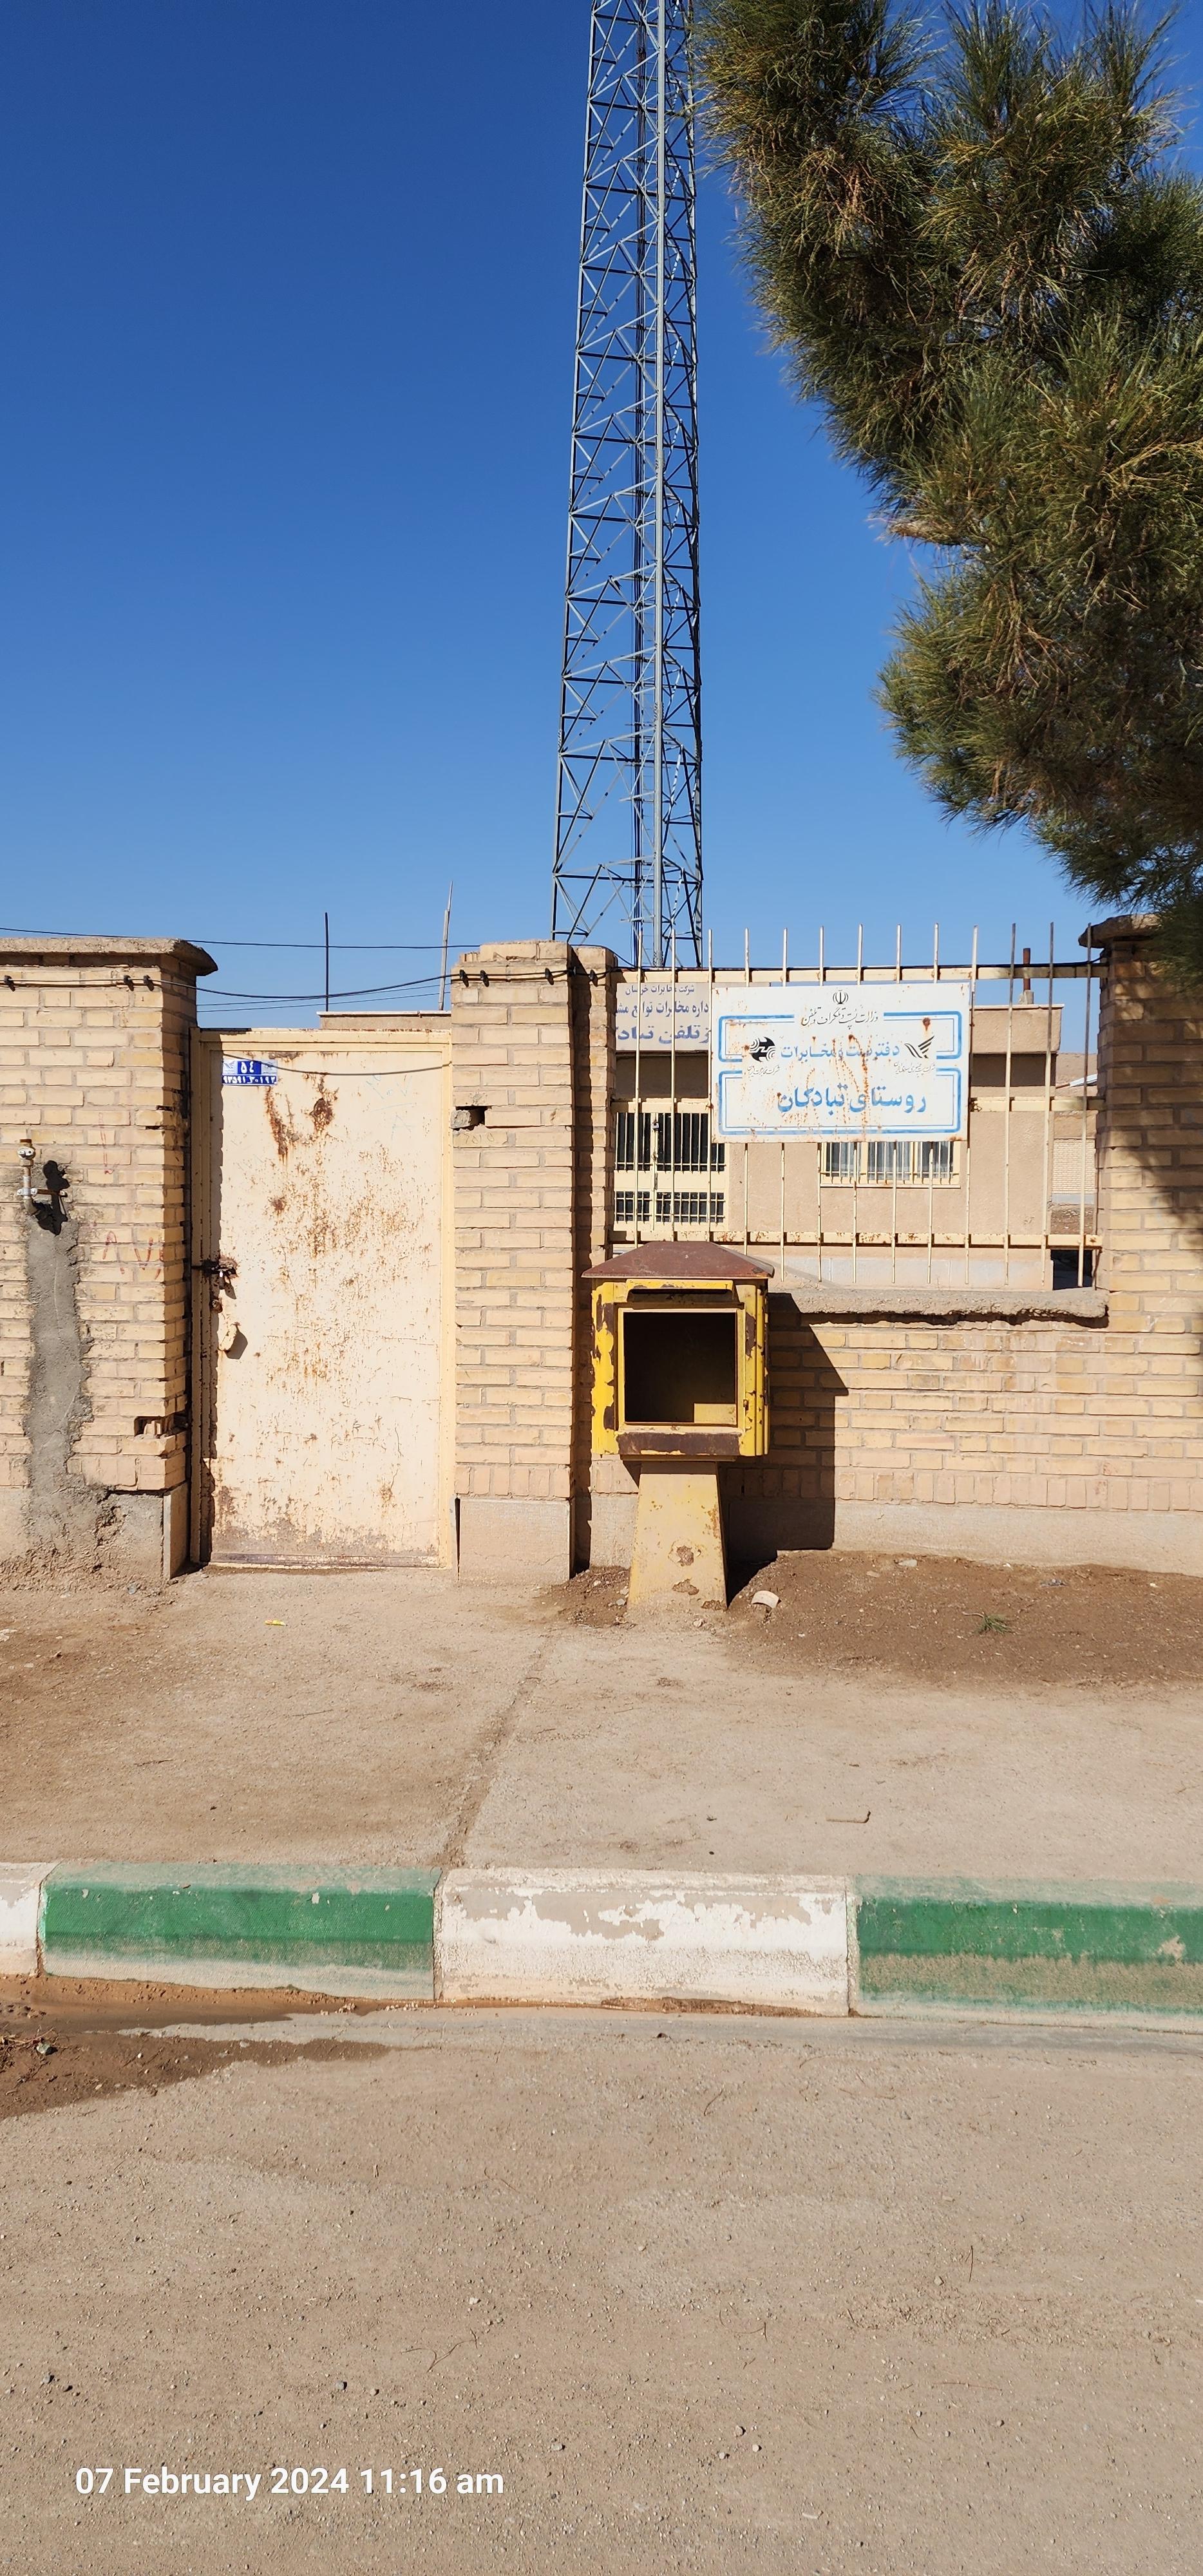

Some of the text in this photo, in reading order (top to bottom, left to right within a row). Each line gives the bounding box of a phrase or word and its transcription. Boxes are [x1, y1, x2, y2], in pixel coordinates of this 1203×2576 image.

[679, 985, 694, 995] شرکت
[781, 1043, 837, 1063] مخابرات
[873, 1041, 900, 1061] دفتر
[849, 1085, 927, 1114] روستای
